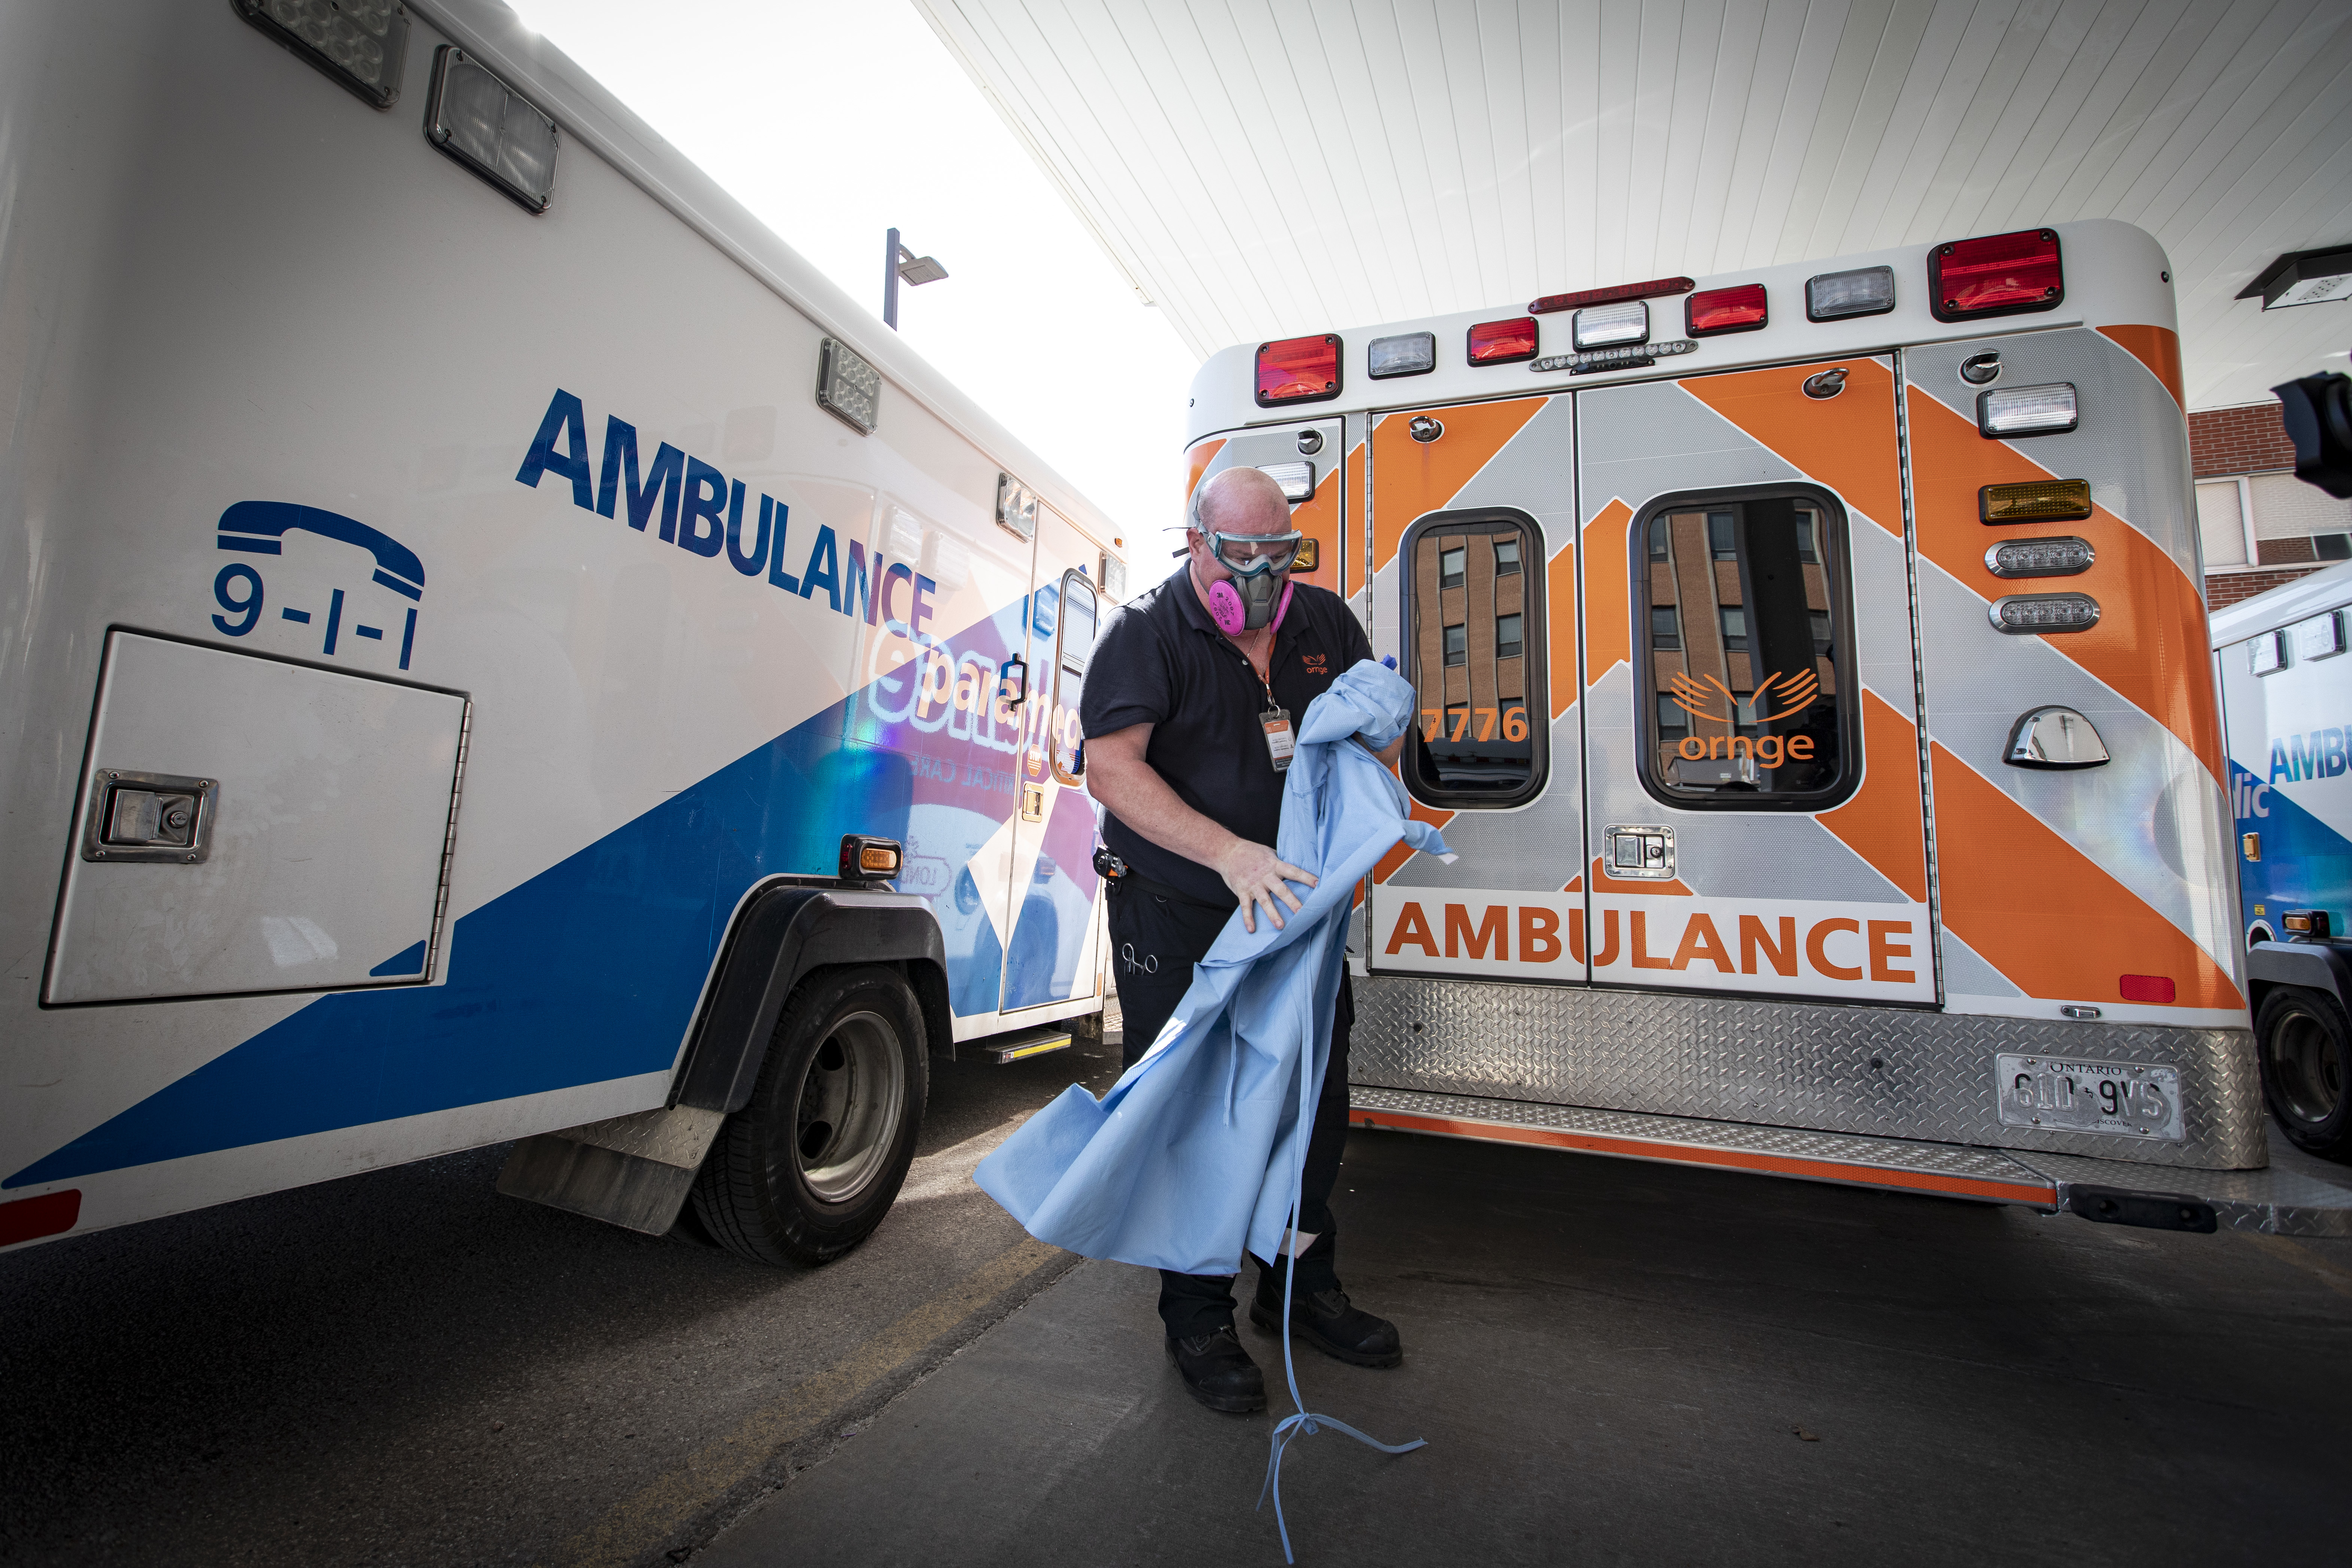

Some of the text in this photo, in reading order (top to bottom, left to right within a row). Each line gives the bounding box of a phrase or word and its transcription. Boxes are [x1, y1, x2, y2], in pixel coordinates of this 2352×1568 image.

[515, 388, 936, 649] AMBULANCE
[212, 563, 418, 671] 9-1-1
[1213, 602, 1223, 621] 2097
[1225, 597, 1234, 616] 2097
[1421, 706, 1528, 743] 7776
[1029, 750, 1041, 762] STOP
[1679, 734, 1815, 769] ornge
[1384, 902, 1916, 983] AMBULANCE
[2049, 1061, 2122, 1077] ONTARIO
